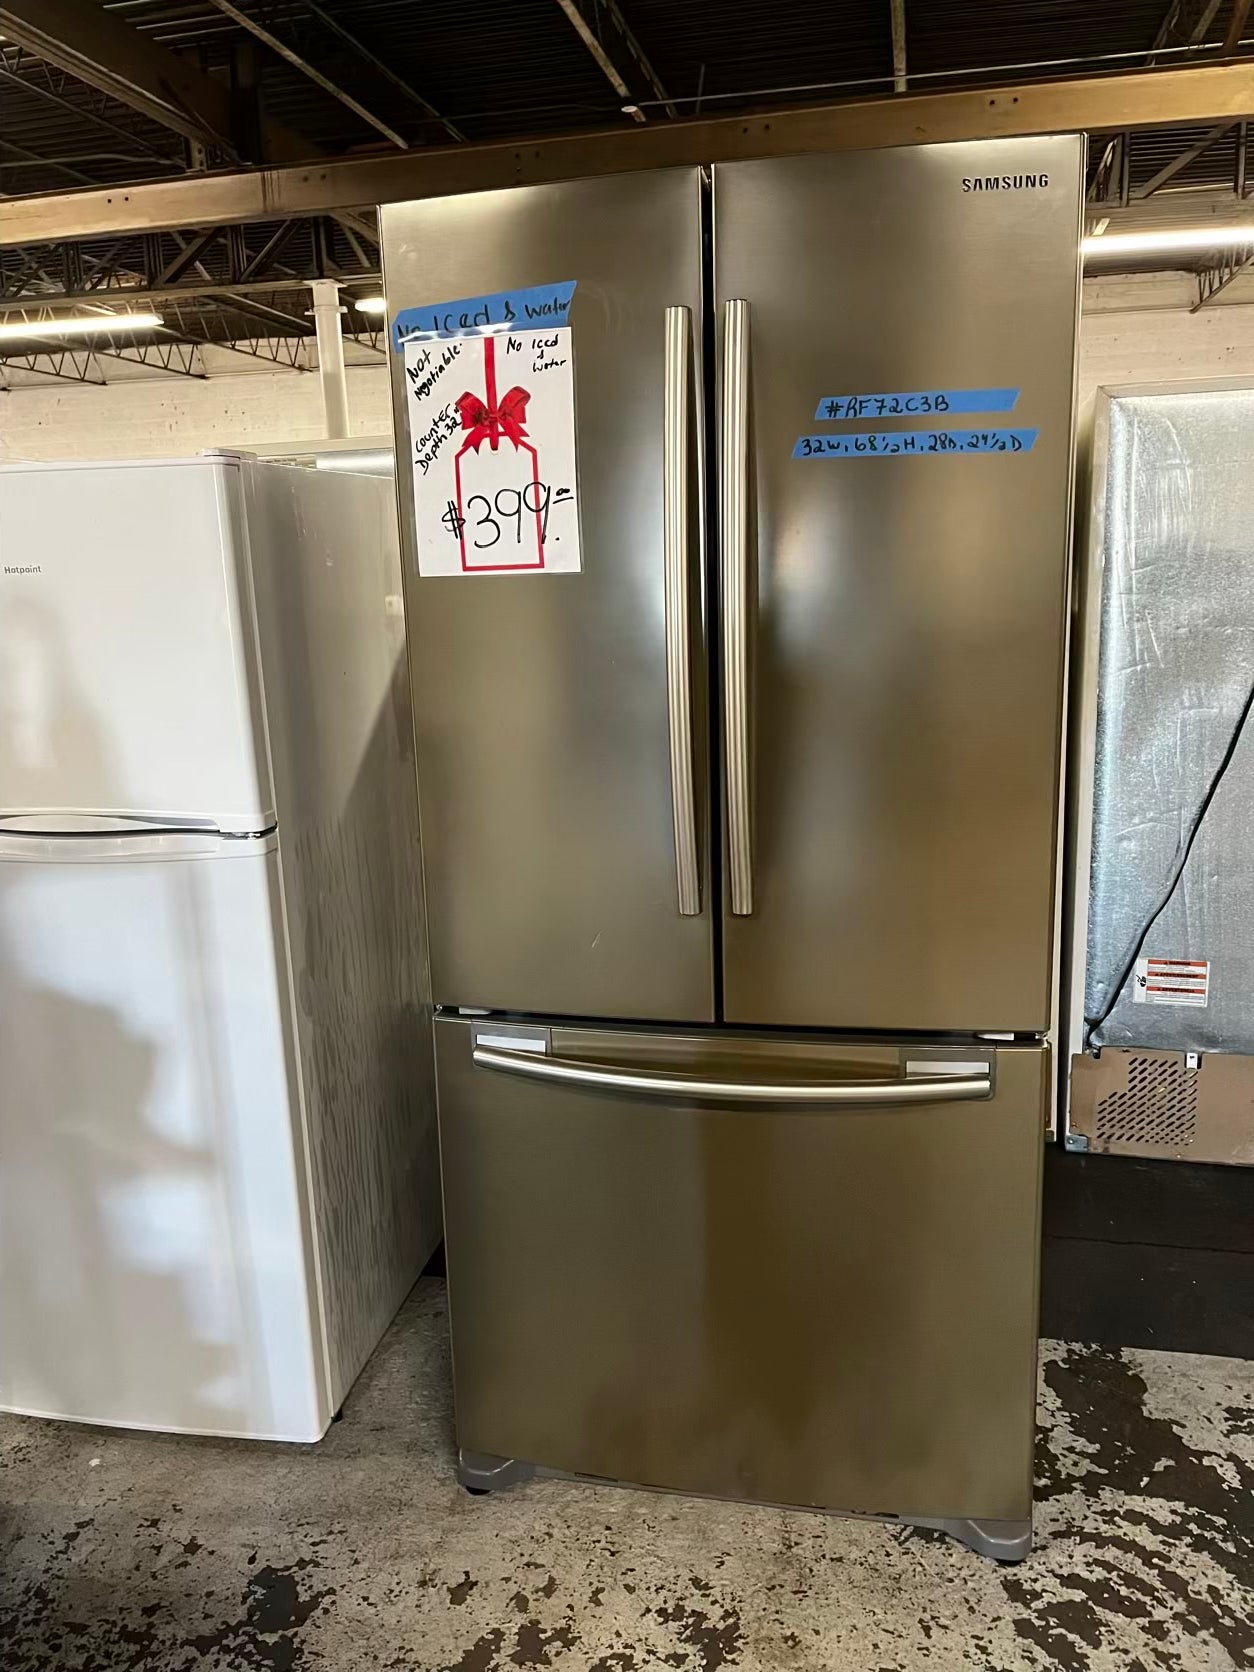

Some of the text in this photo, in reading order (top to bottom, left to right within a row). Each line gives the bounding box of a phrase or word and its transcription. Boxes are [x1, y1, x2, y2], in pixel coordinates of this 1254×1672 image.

[962, 174, 1049, 192] SAMSUNG
[506, 336, 522, 354] No
[415, 433, 448, 476] Depth
[4, 564, 42, 575] Hotpoint
